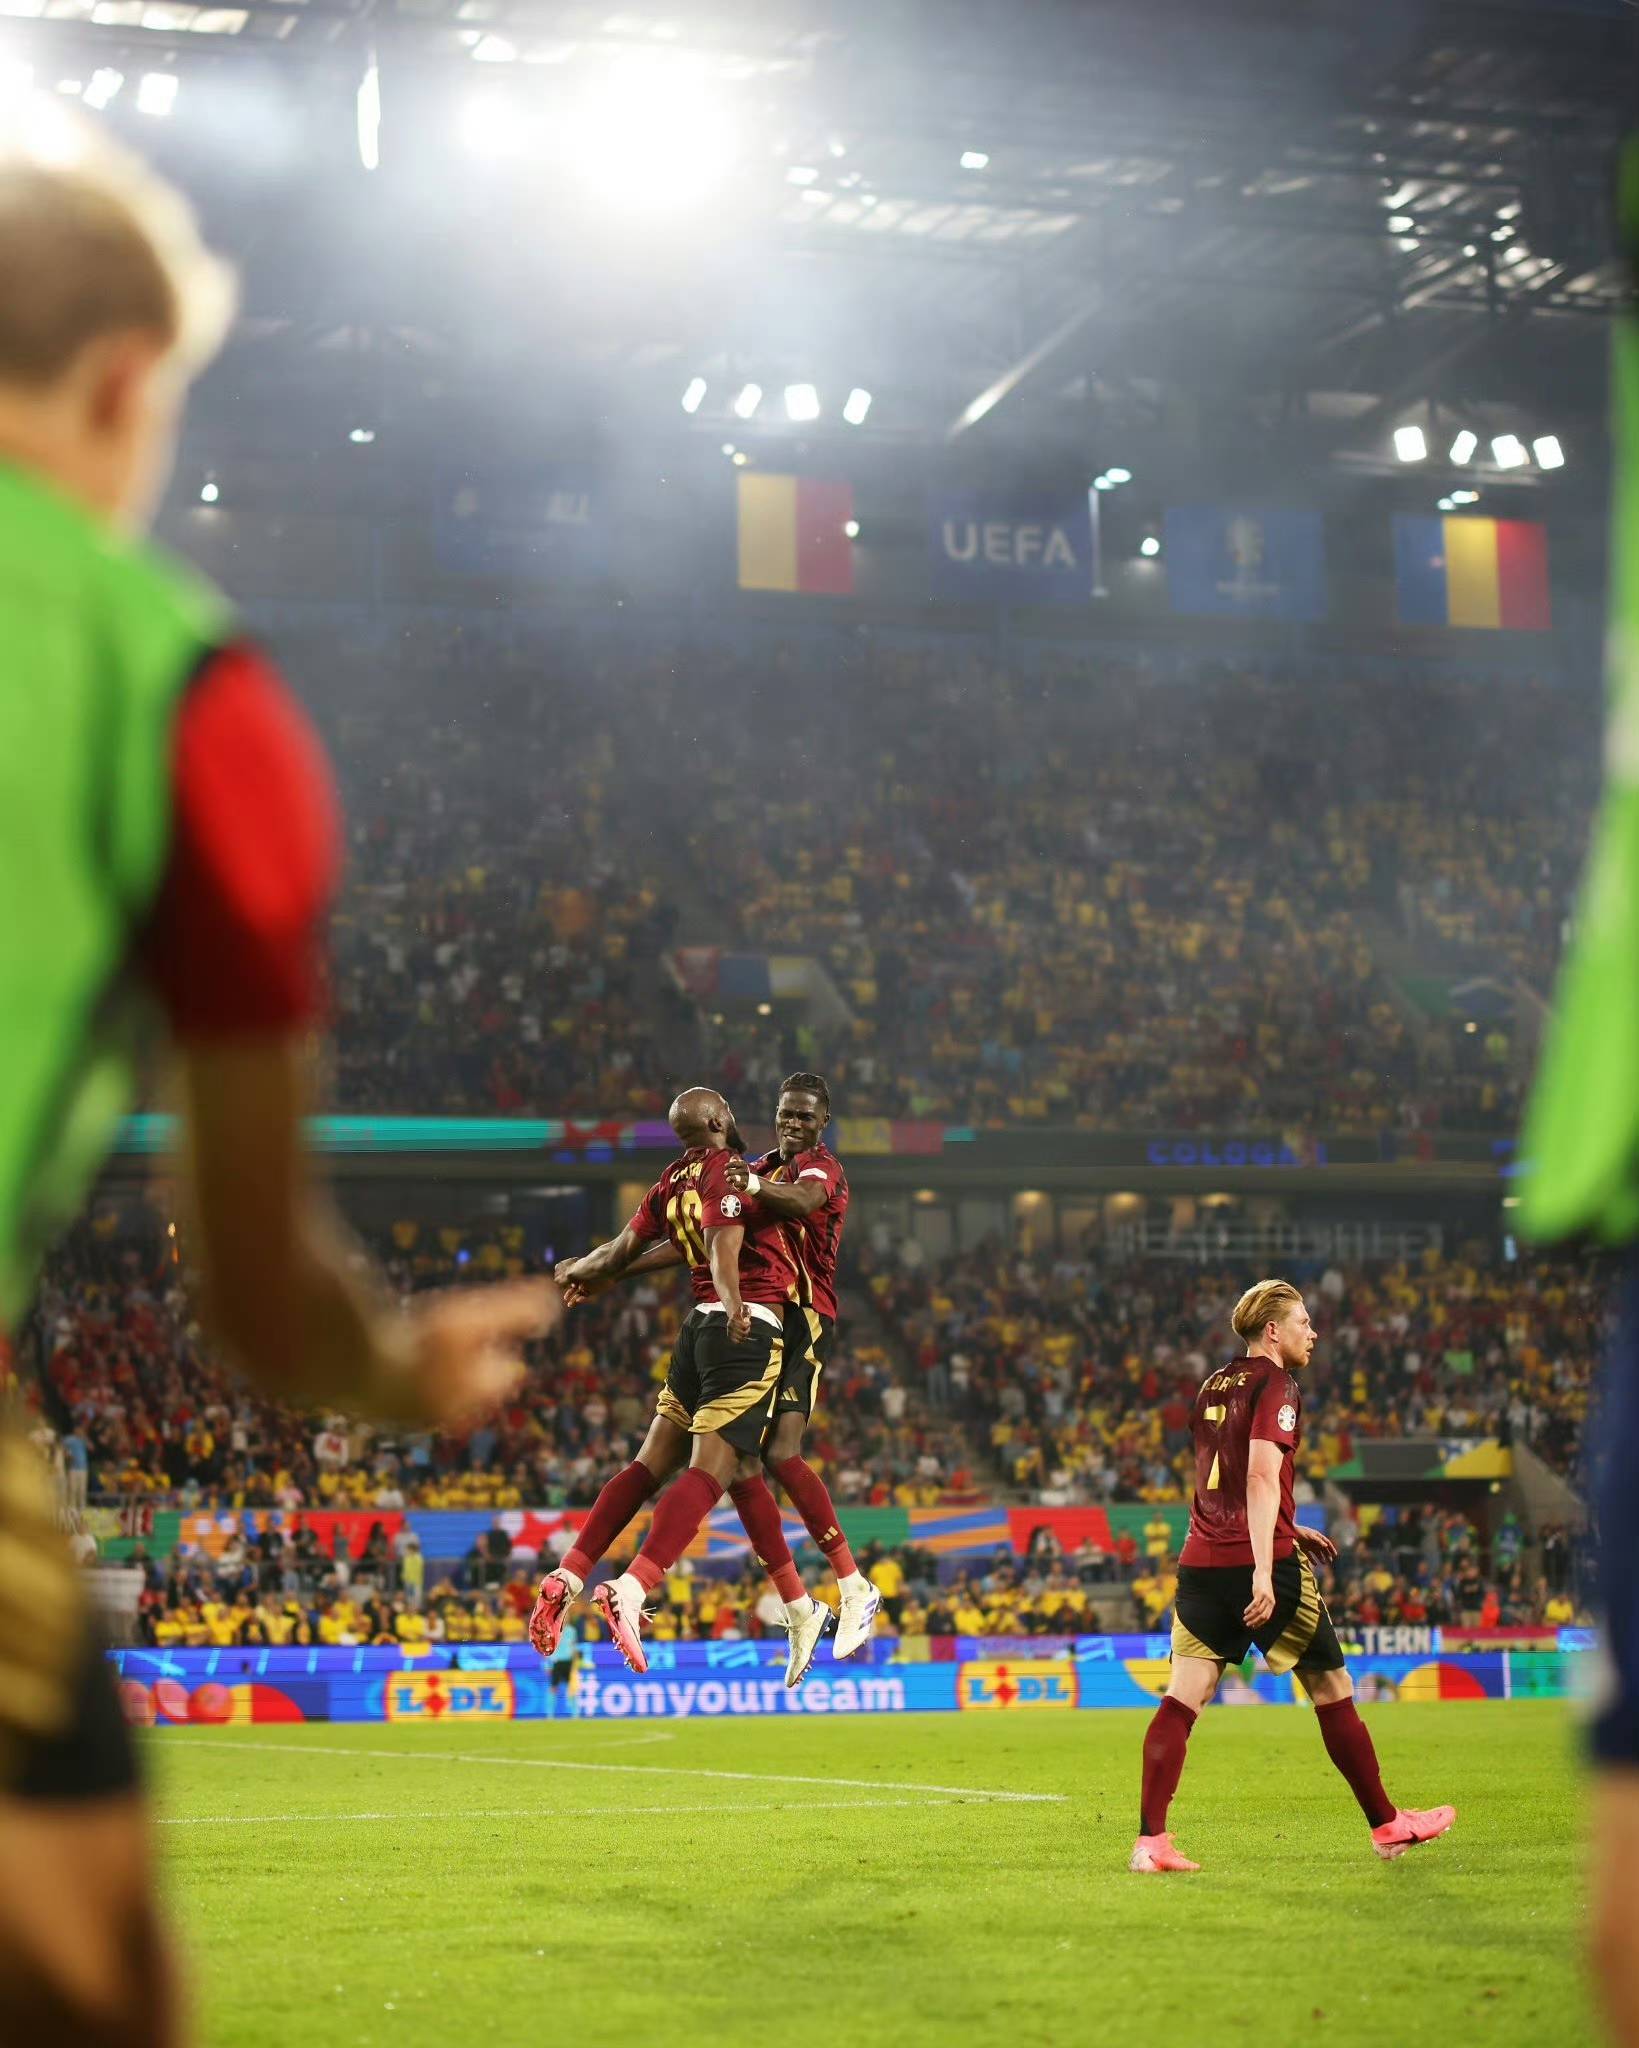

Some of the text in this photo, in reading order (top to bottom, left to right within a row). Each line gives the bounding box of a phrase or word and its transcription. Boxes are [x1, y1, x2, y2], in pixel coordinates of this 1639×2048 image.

[943, 521, 1077, 568] UEFA
[1146, 1138, 1329, 1166] COLOG
[1204, 1403, 1227, 1490] 7
[575, 1672, 906, 1718] #onyourteam
